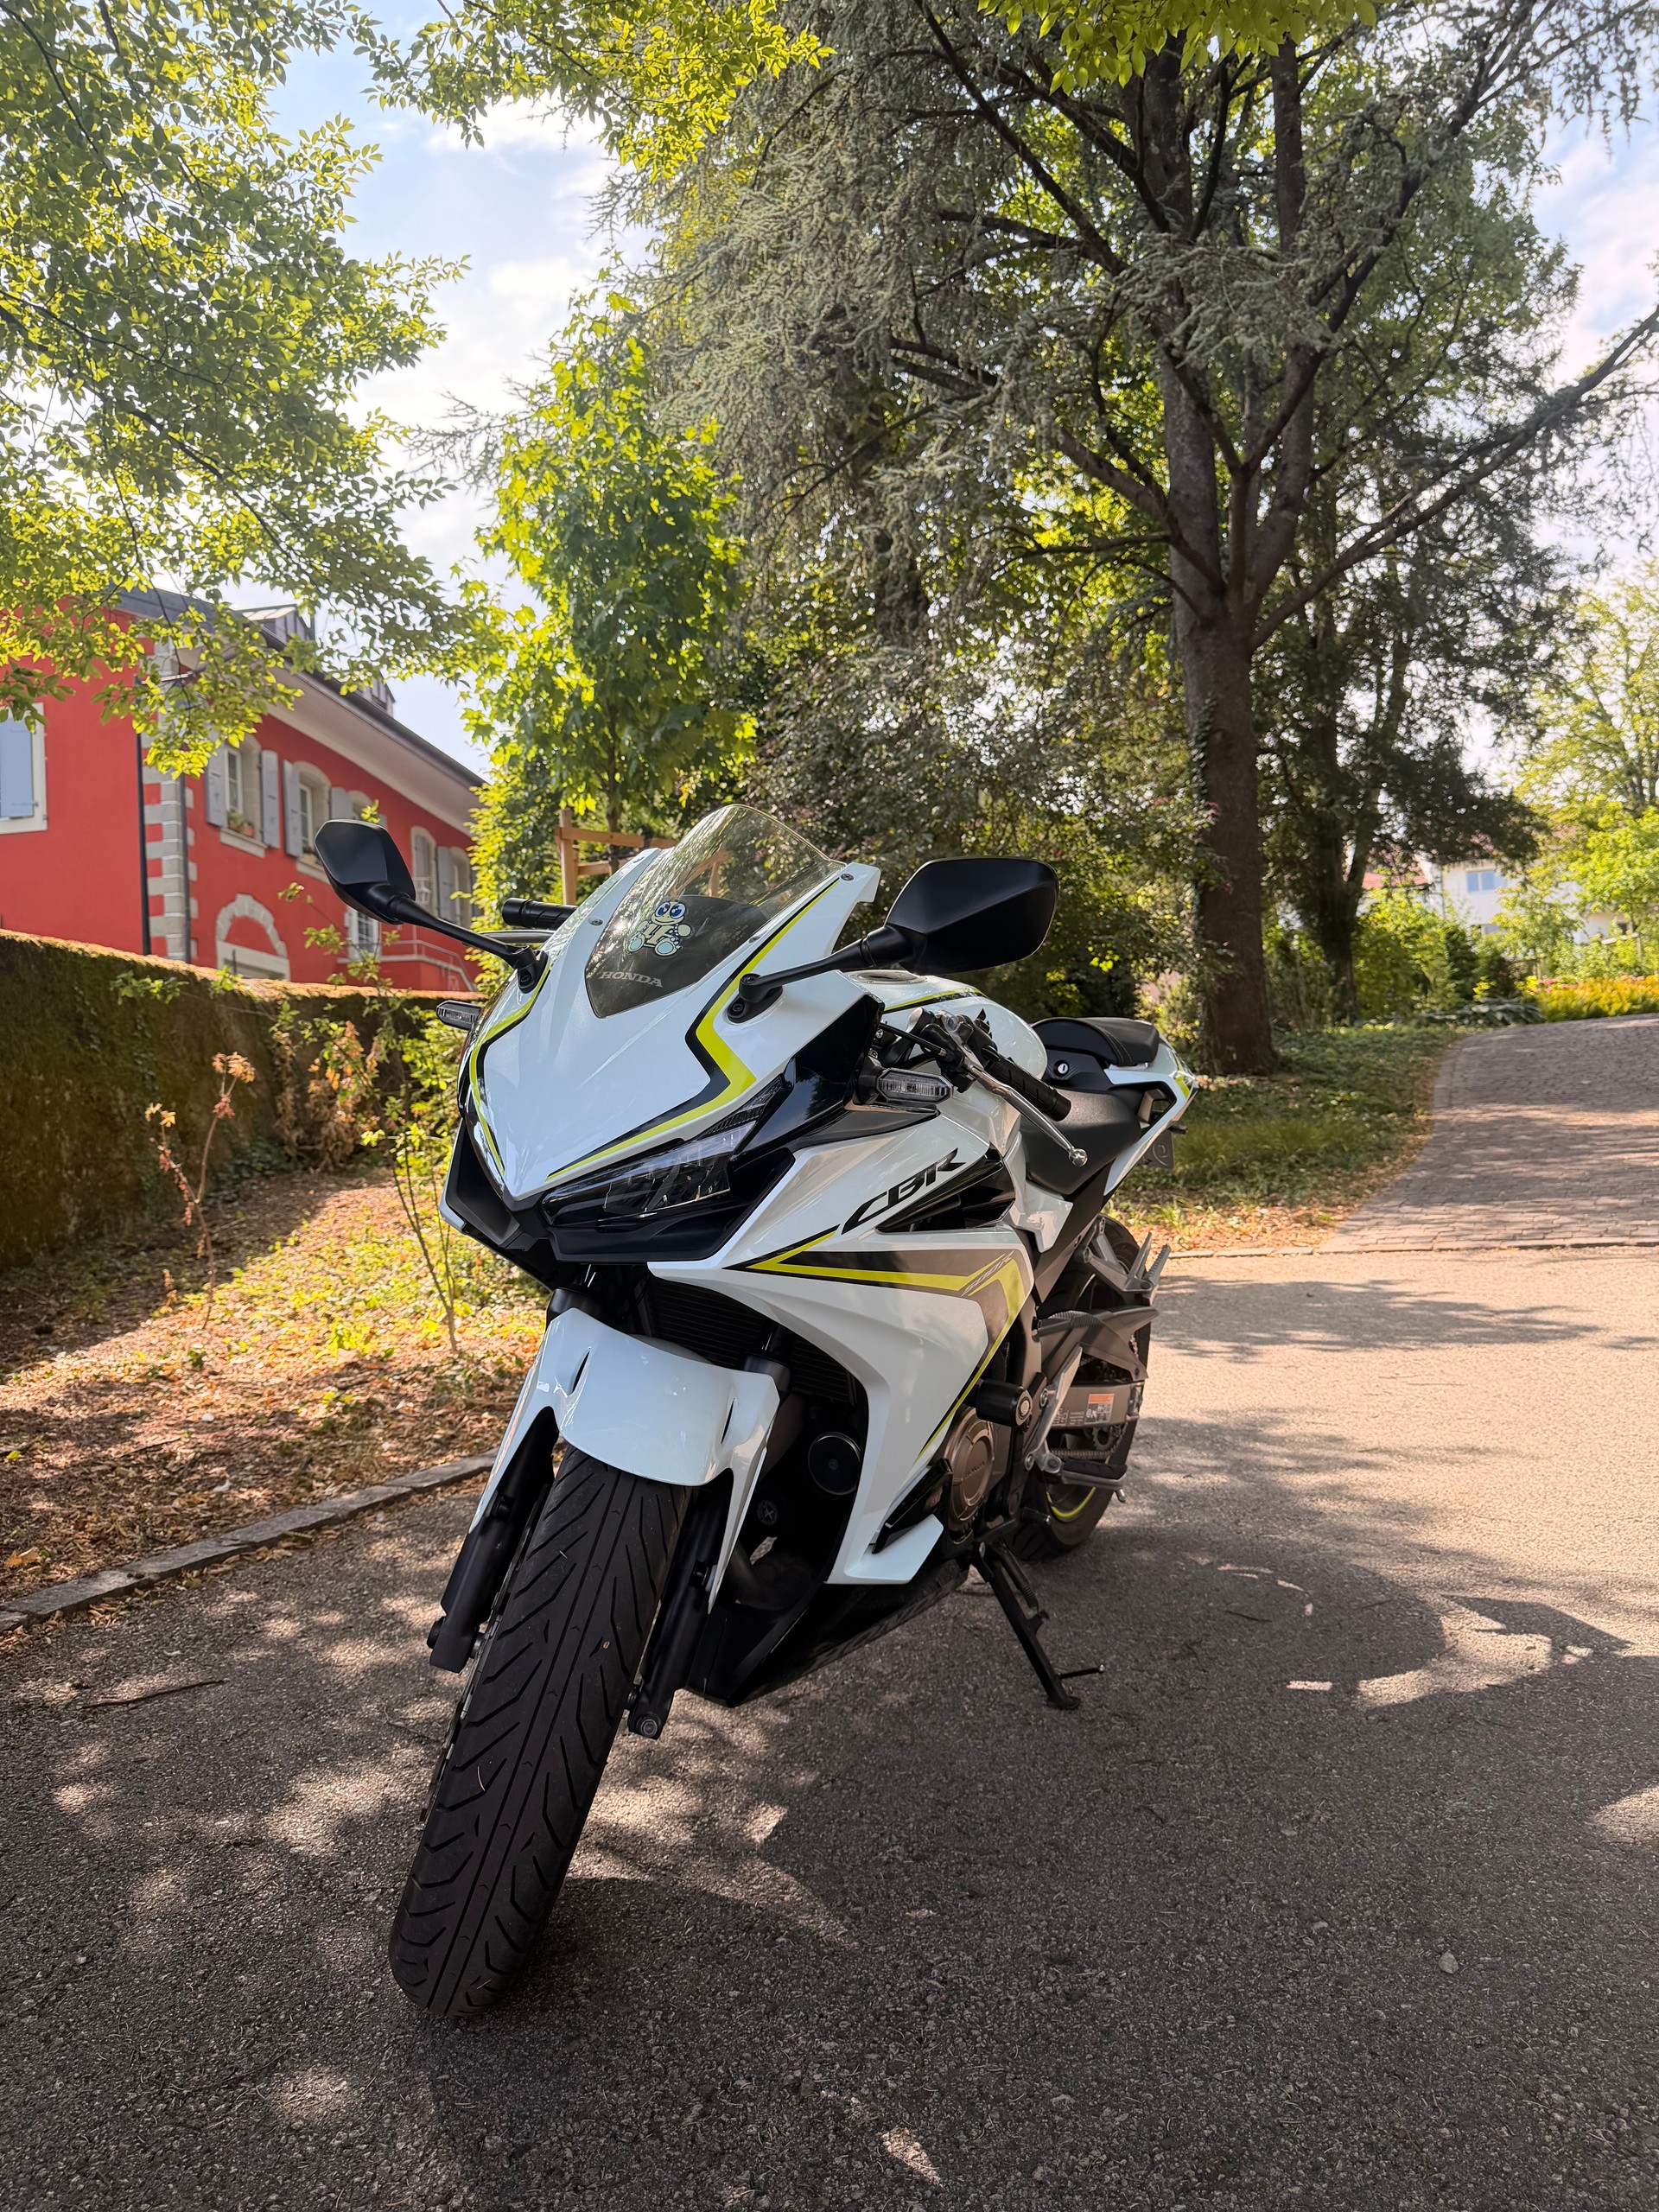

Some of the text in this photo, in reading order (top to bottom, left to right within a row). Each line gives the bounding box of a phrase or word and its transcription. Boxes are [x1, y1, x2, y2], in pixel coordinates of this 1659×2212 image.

[599, 971, 663, 988] HONDA
[841, 1147, 966, 1235] CBR
[961, 1249, 1015, 1297] 500R
